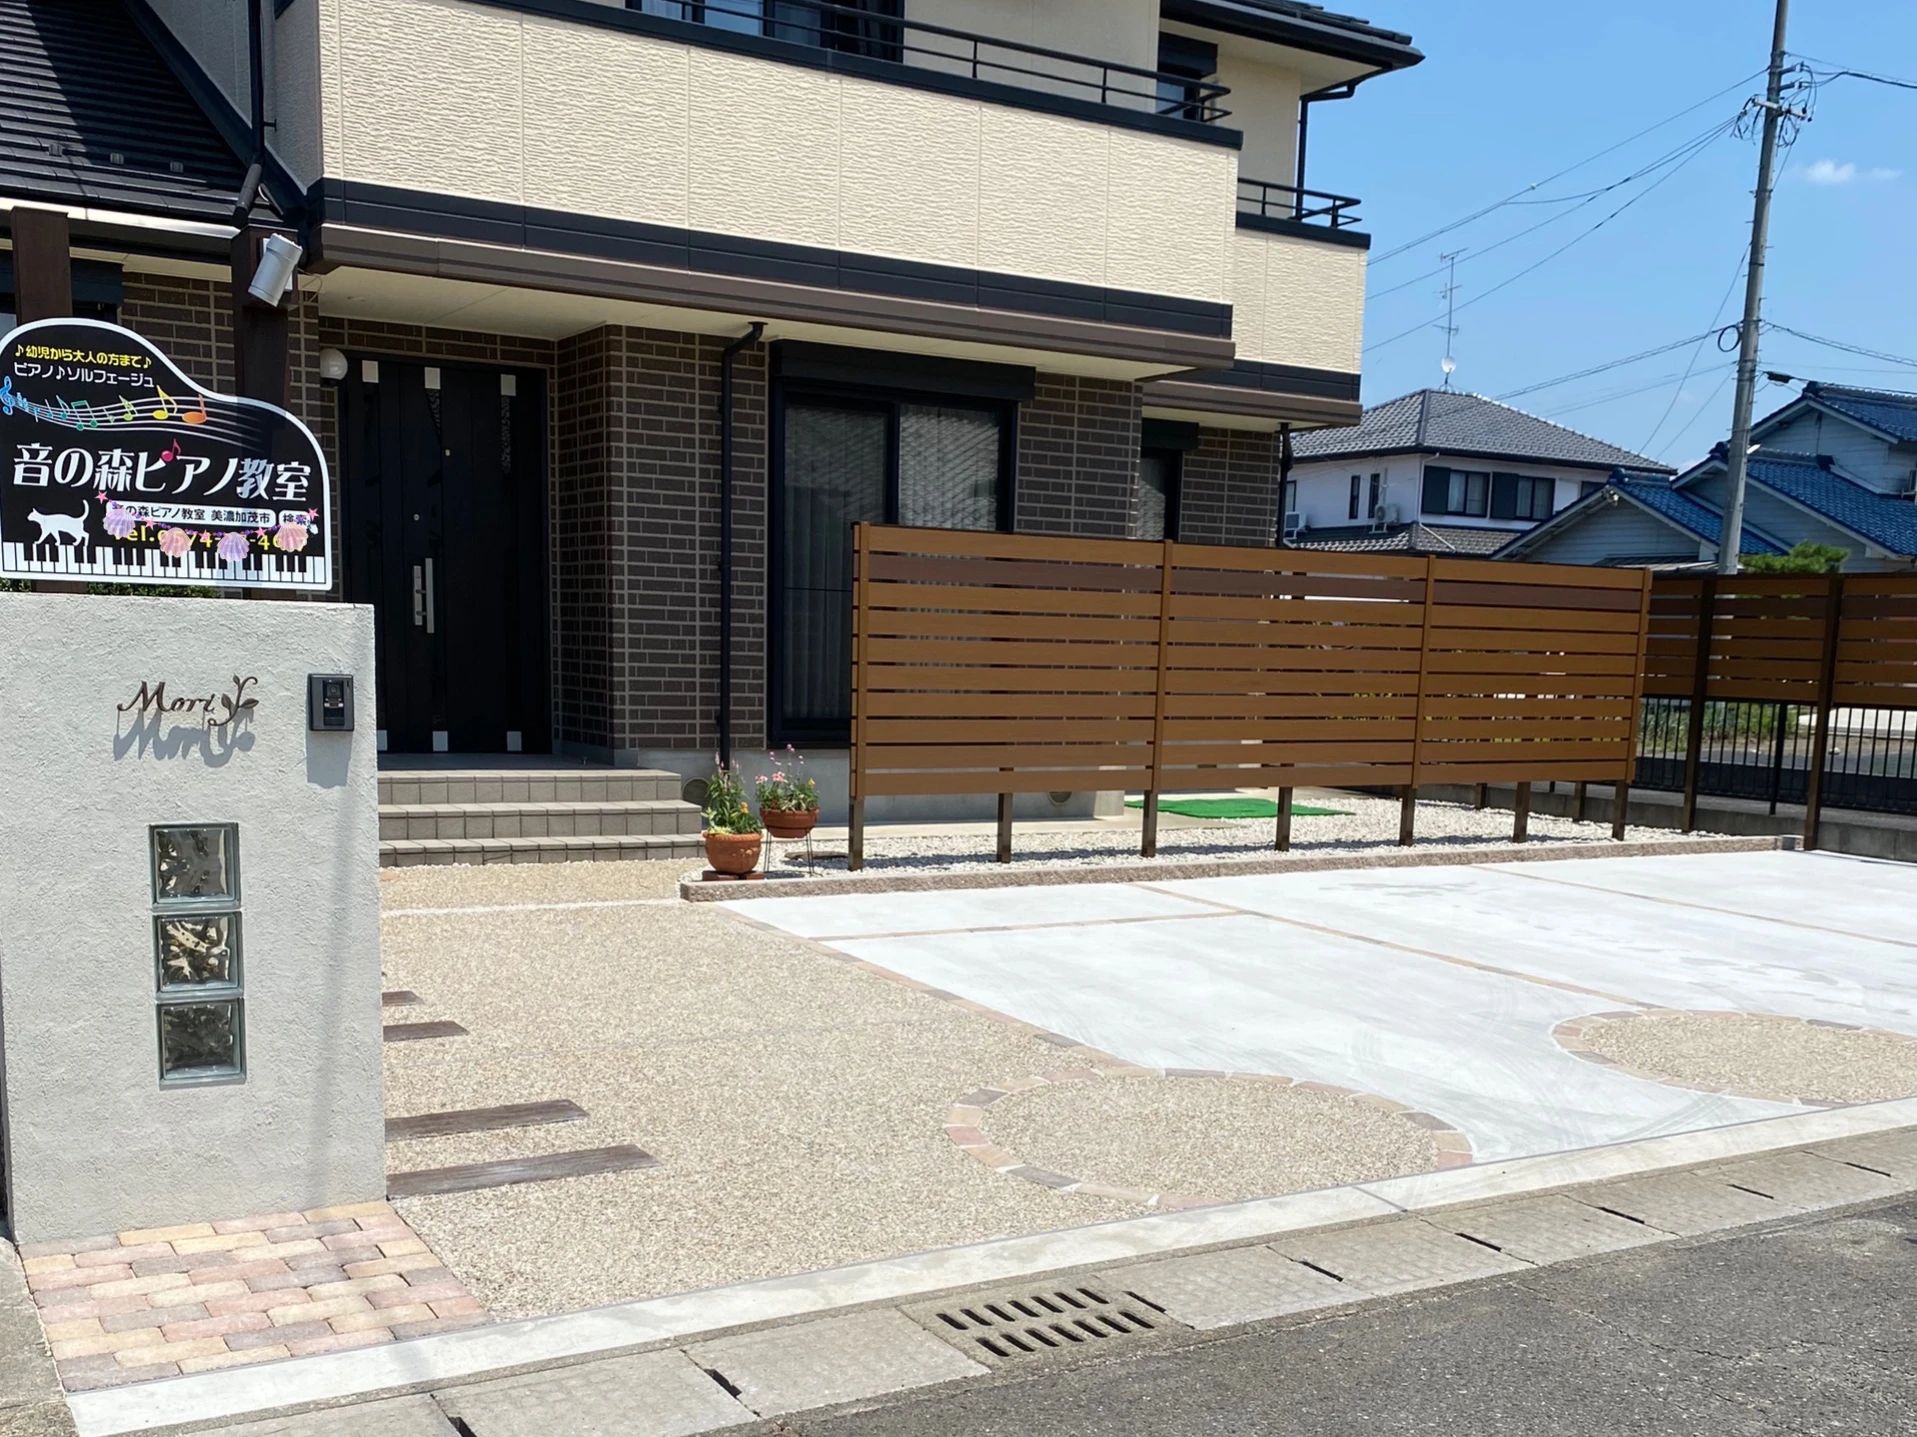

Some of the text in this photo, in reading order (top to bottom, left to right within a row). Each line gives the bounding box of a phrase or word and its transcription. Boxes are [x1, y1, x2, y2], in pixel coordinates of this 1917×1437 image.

[13, 442, 311, 502] 音の森ピアノ教室
[115, 502, 271, 524] の森ピアノ教室 美濃加茂市
